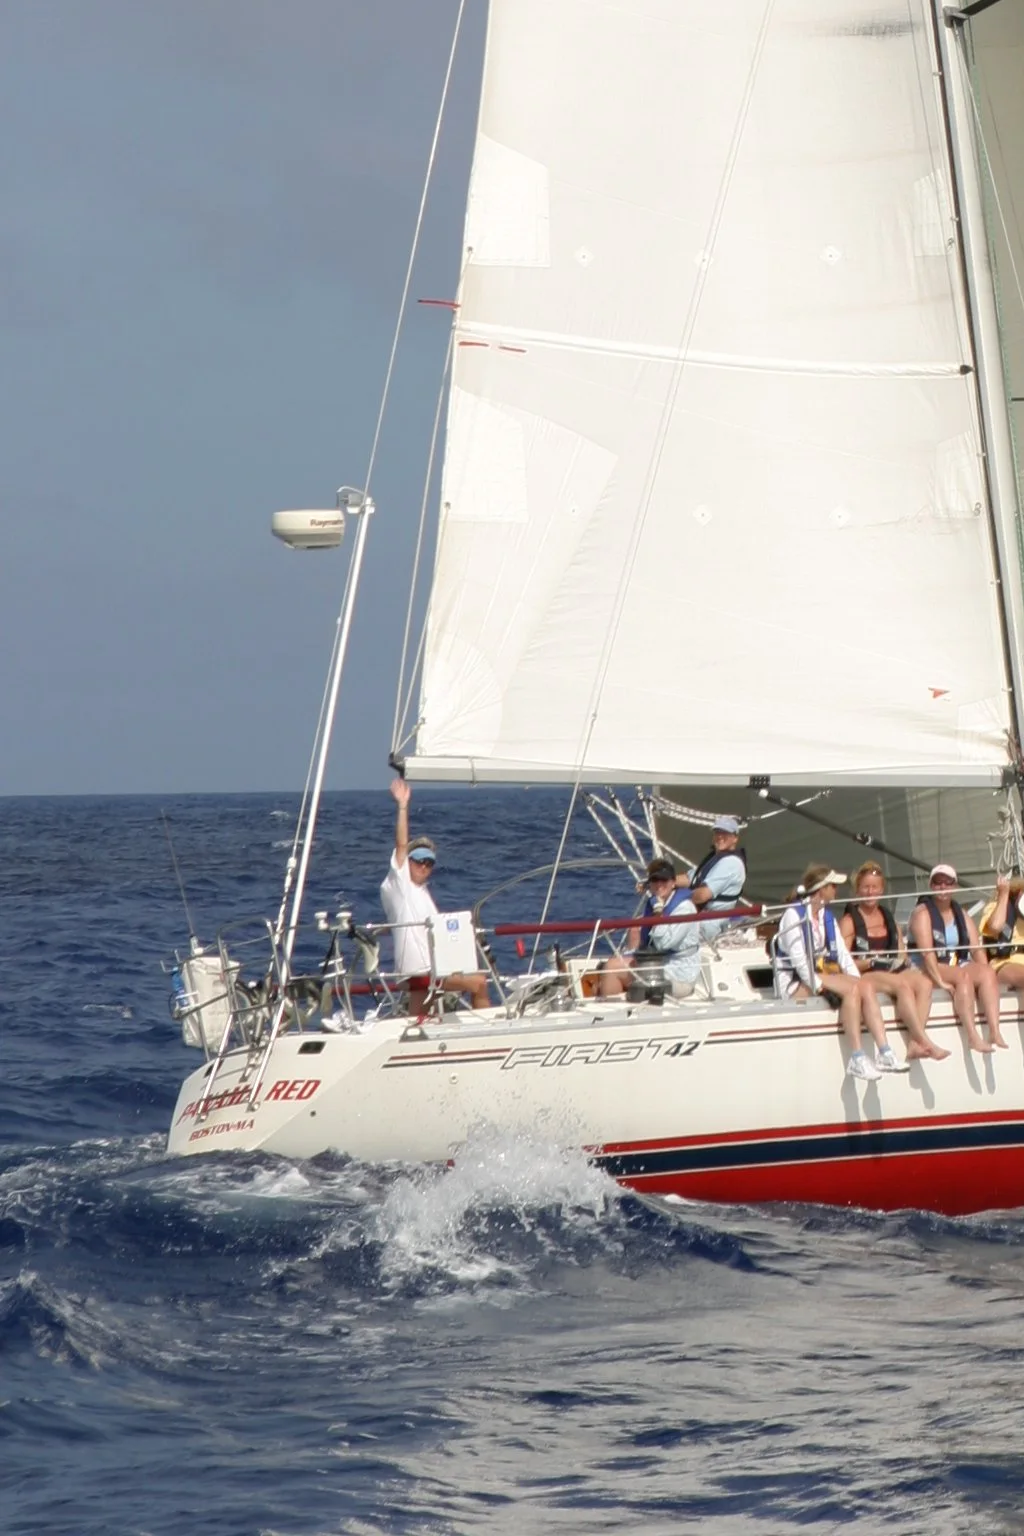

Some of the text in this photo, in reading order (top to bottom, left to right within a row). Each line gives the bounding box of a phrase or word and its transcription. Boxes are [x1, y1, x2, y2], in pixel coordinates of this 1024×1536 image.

[500, 1035, 700, 1070] FIRST 42
[264, 1079, 322, 1102] RED
